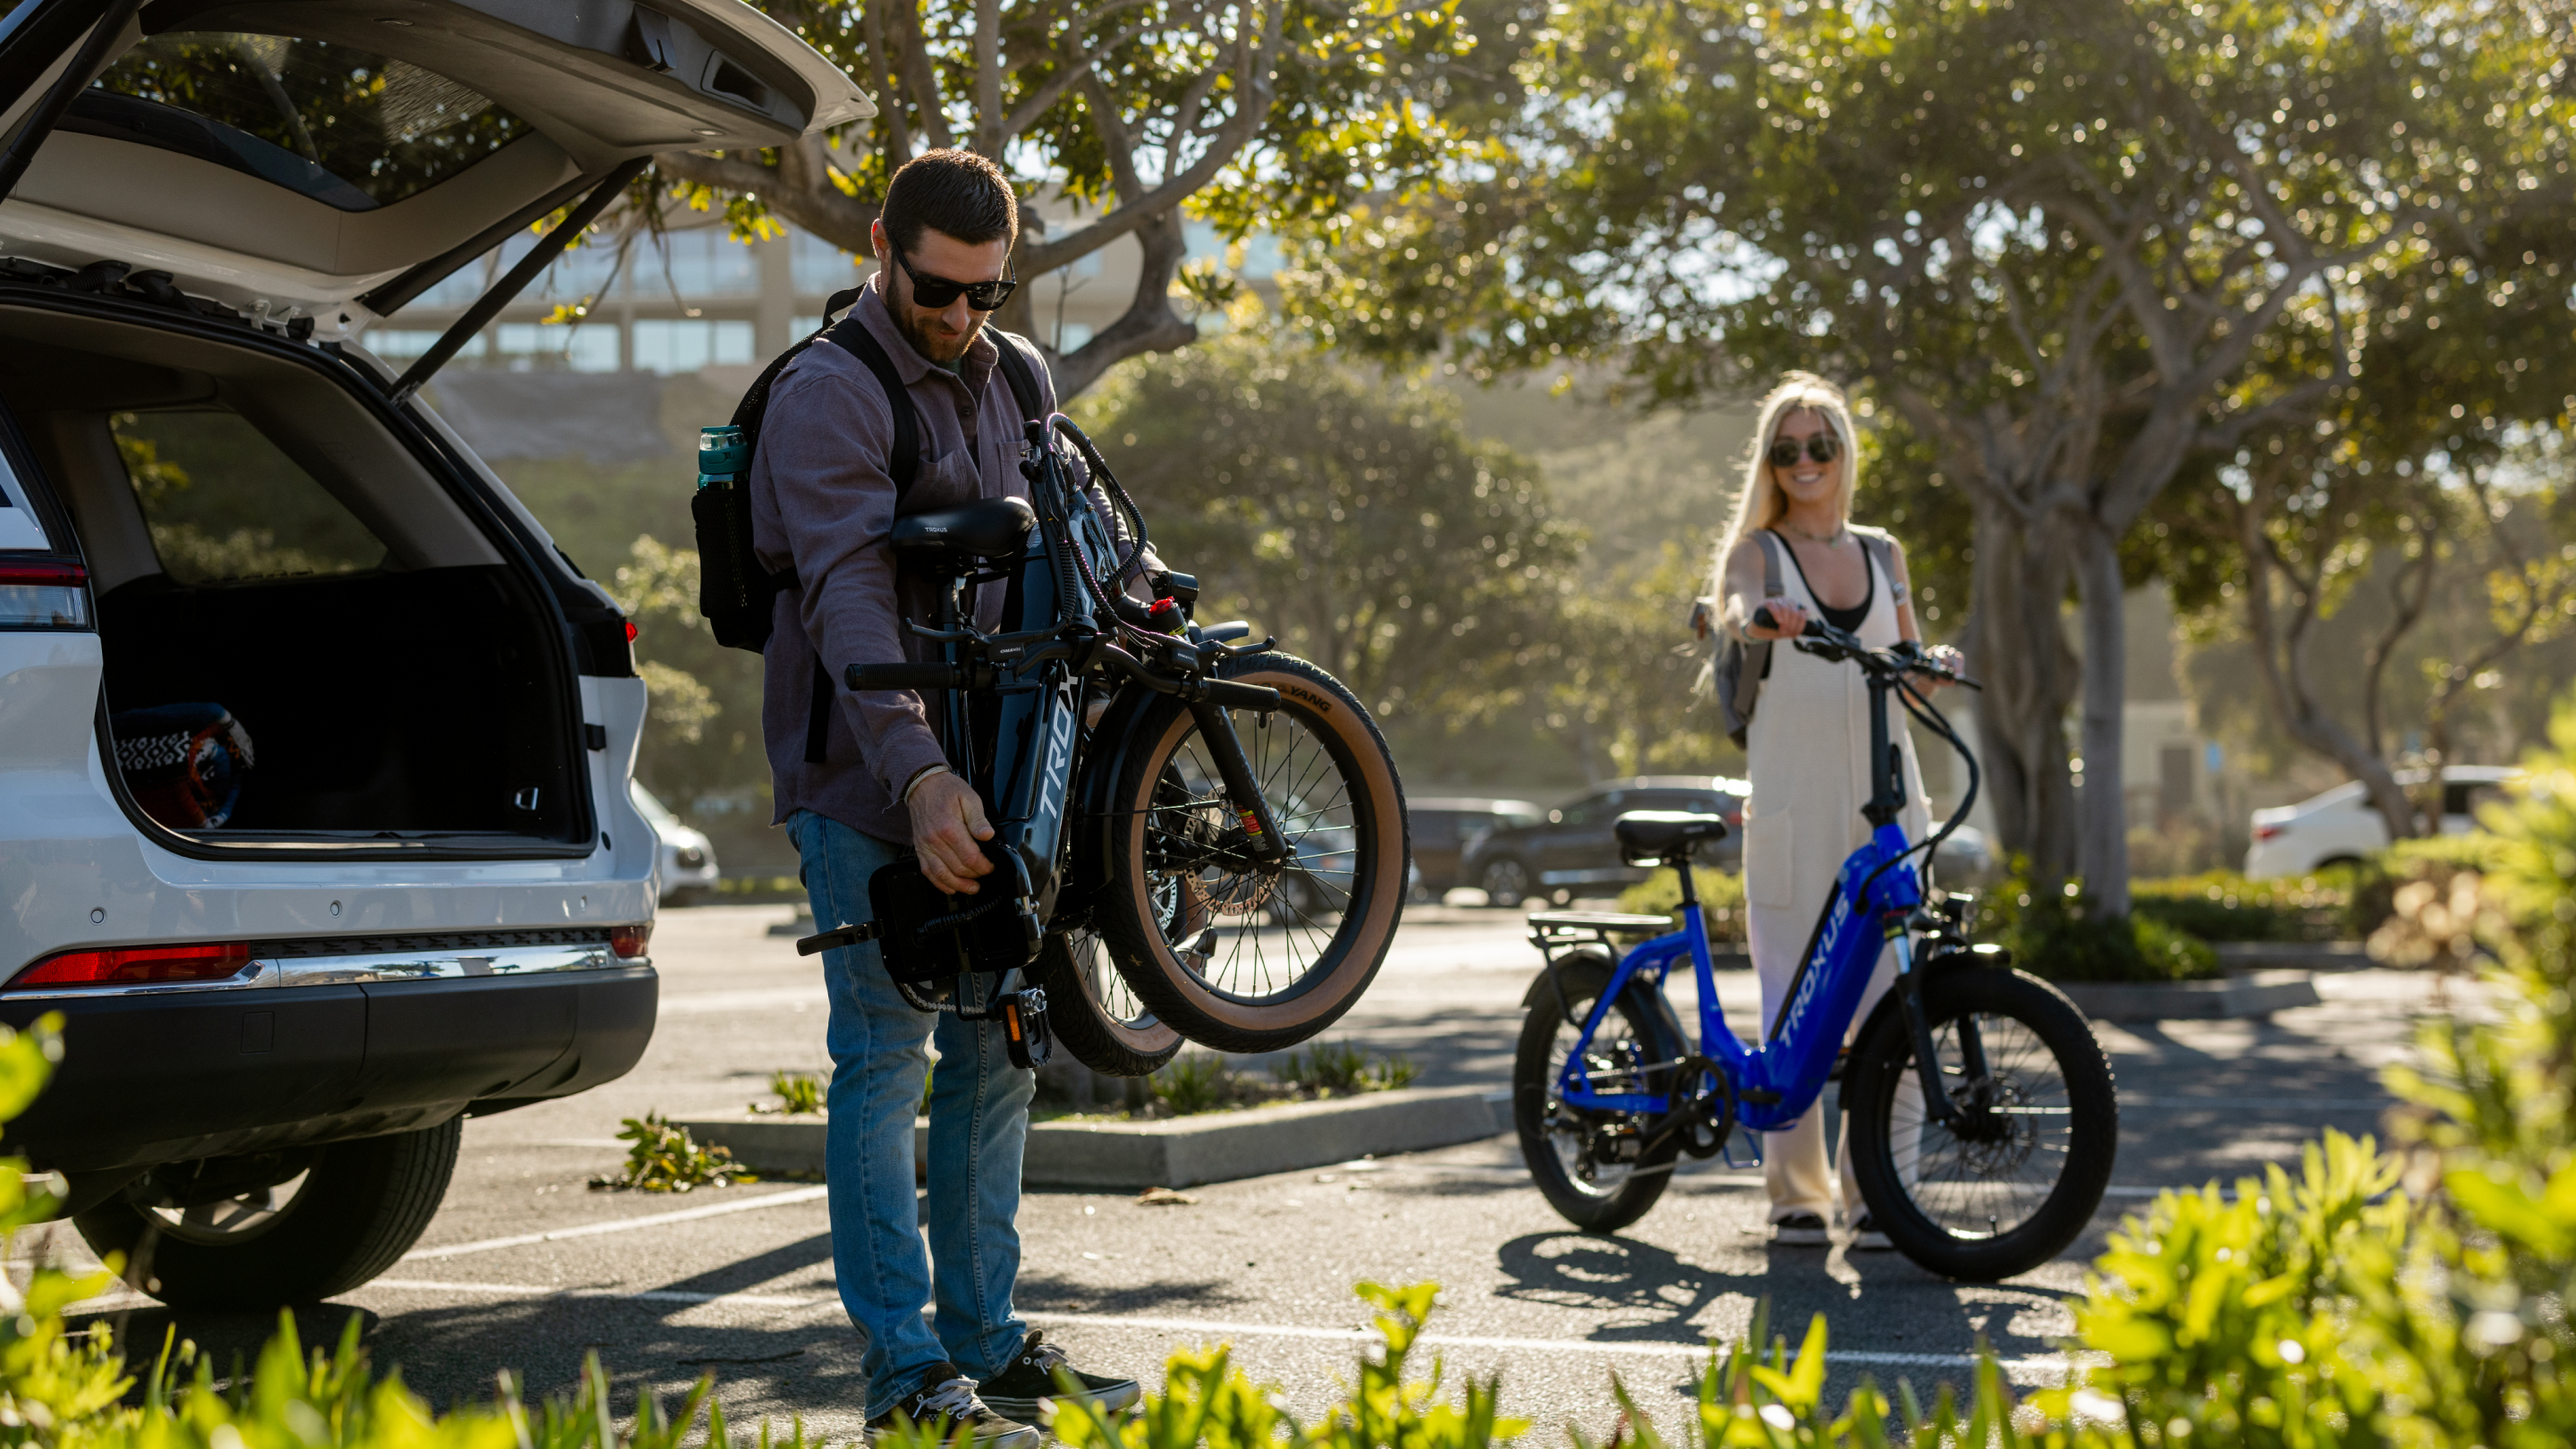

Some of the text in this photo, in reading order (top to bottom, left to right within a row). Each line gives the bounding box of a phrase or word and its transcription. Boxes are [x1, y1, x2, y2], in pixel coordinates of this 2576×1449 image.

[1039, 659, 1079, 819] TROX
[1291, 686, 1331, 712] YANG
[1779, 891, 1850, 1048] TROXUS
